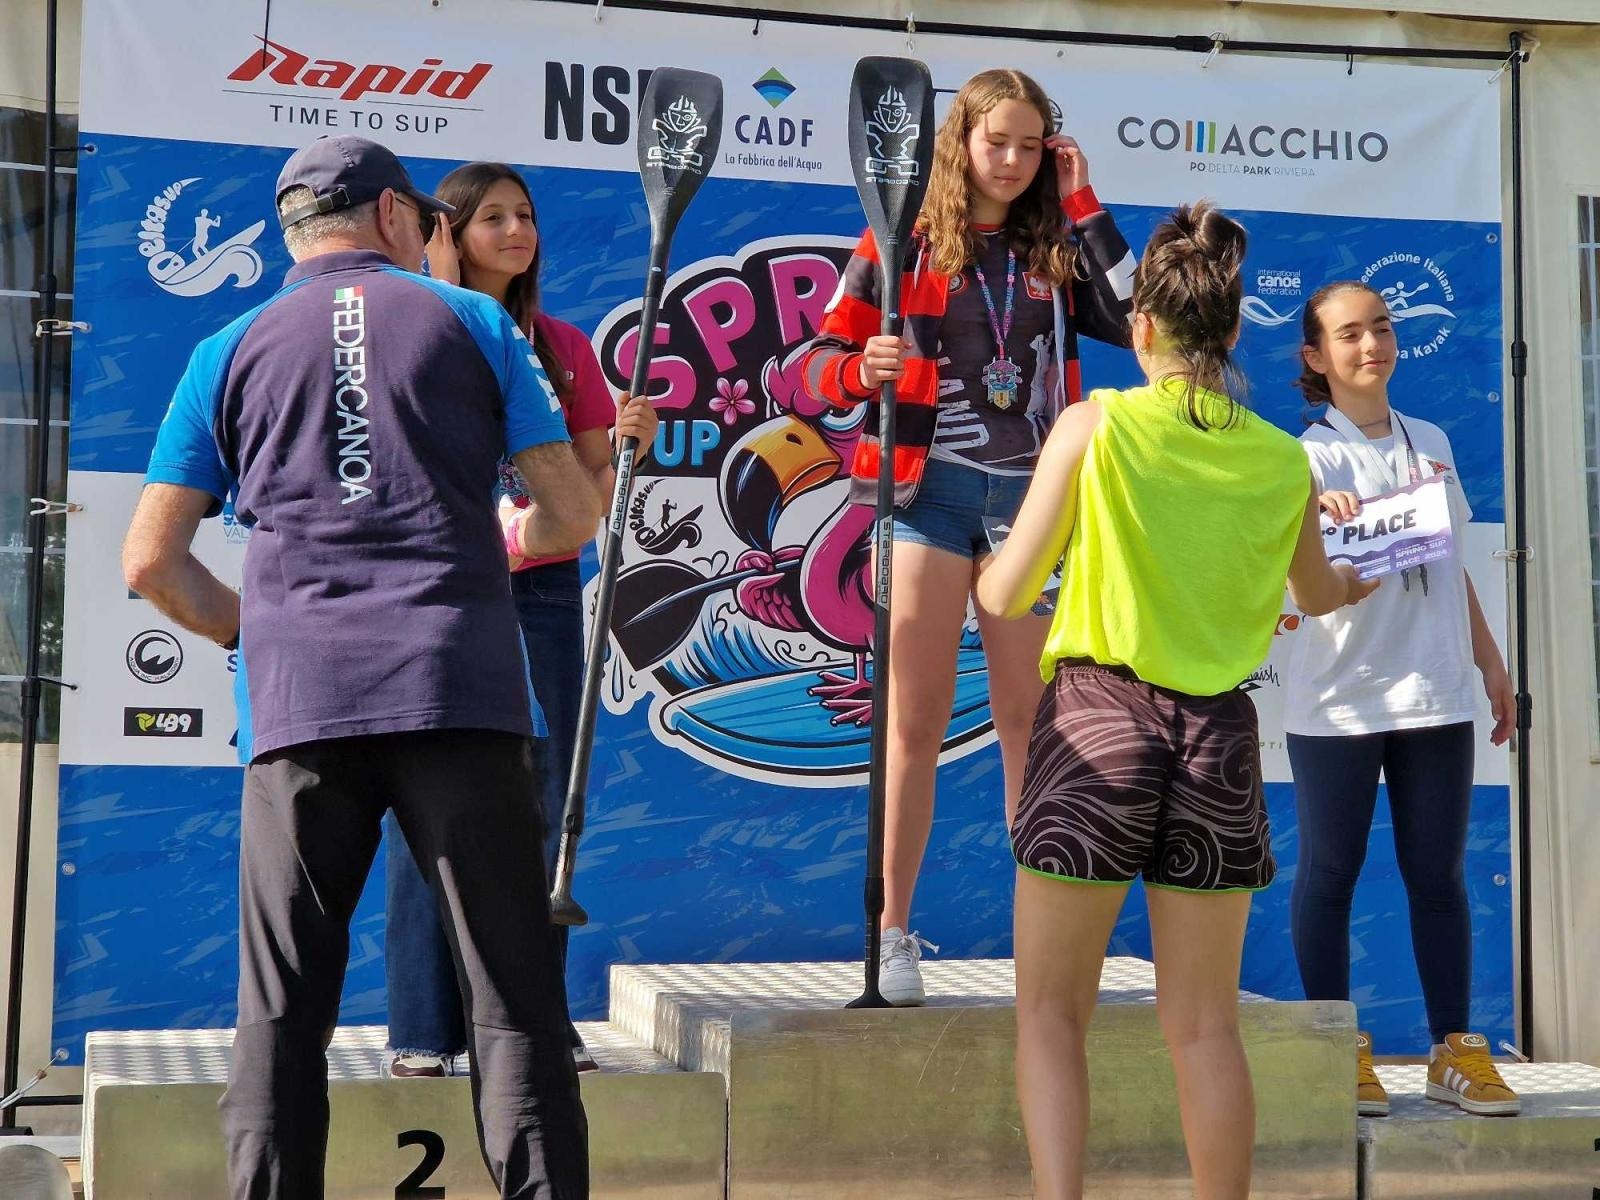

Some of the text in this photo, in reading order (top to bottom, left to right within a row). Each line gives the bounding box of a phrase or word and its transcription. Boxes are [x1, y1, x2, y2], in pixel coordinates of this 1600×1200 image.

[227, 34, 493, 101] Rapid
[269, 104, 449, 134] TIME TO SUP
[544, 61, 654, 146] NS
[734, 114, 814, 148] CADF
[725, 152, 822, 172] La Fabbrica dell'Acqua
[1190, 161, 1316, 177] PO DELTA PARK RIVIERA
[1257, 275, 1301, 288] canoe
[1258, 286, 1302, 296] federation
[1360, 251, 1454, 302] ederazione Italiana
[1413, 326, 1451, 359] Kayak
[333, 295, 373, 505] FEDERCANOA
[652, 419, 721, 468] UP
[1342, 508, 1417, 545] PLACE
[1395, 545, 1427, 559] SPRING
[1428, 539, 1447, 549] SUP
[1396, 555, 1421, 568] RACE
[394, 1129, 446, 1200] 2
